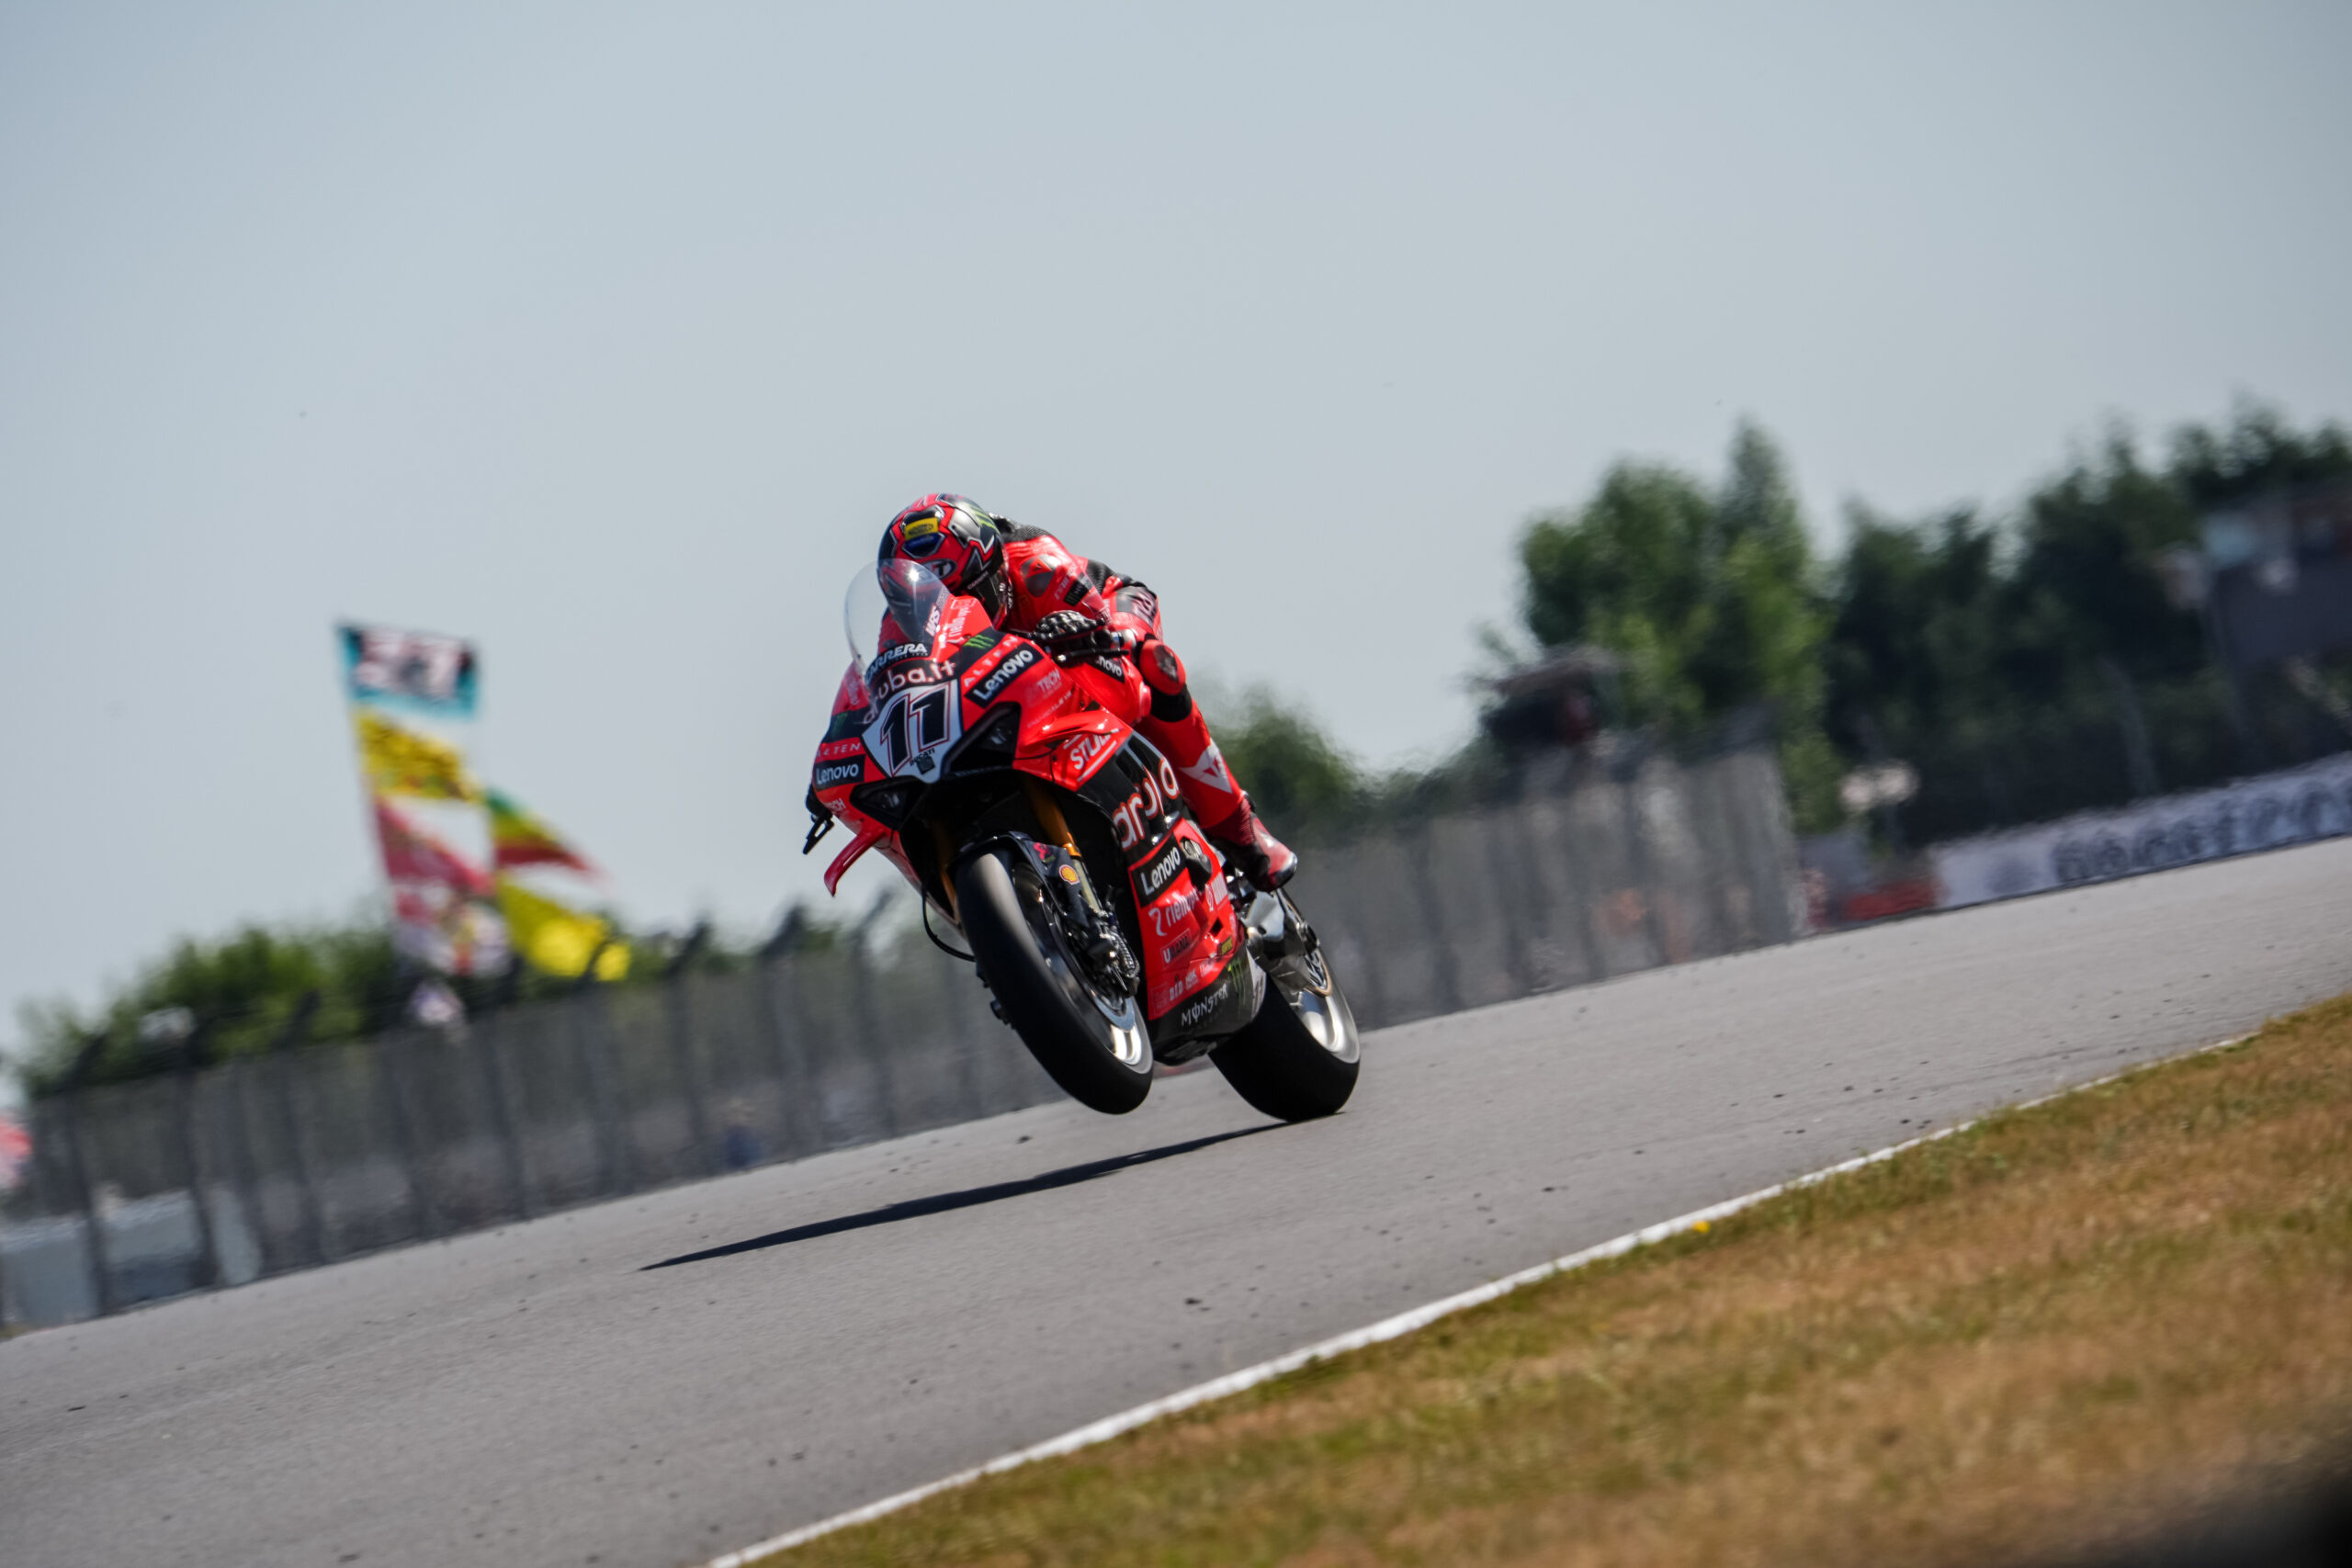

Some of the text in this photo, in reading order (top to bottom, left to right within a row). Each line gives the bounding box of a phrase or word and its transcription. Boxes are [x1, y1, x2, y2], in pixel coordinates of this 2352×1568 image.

[973, 649, 1034, 701] Lenovo
[879, 681, 951, 777] 11
[815, 763, 860, 785] Lenovo
[1140, 846, 1182, 897] Lenovo
